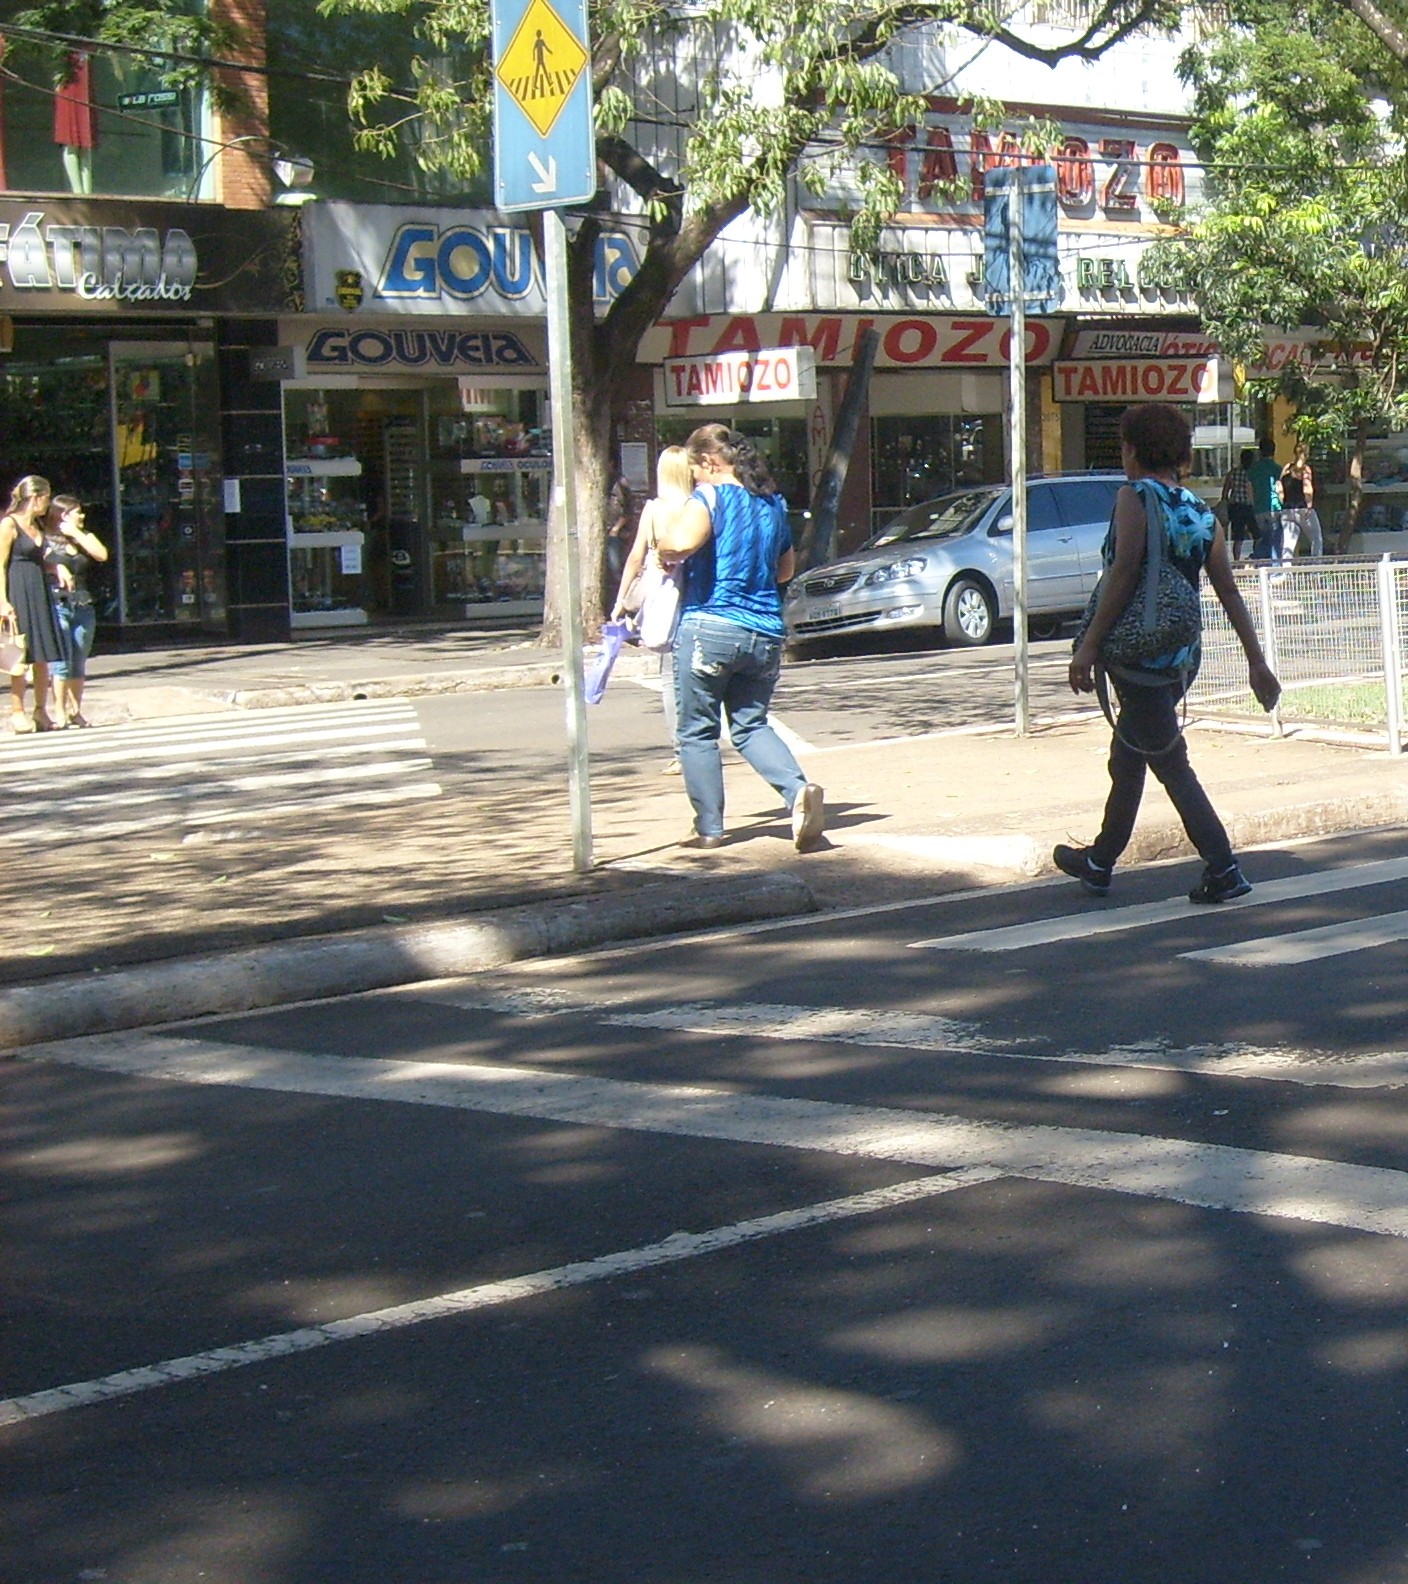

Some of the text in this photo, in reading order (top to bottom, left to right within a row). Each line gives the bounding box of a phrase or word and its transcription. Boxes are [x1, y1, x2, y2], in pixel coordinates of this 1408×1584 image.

[77, 272, 192, 301] Calçados
[306, 328, 540, 368] GOUVEIA
[1090, 333, 1160, 352] ADVOCACIA
[670, 357, 791, 397] TAMIOZO
[1058, 363, 1214, 396] TAMIOZO
